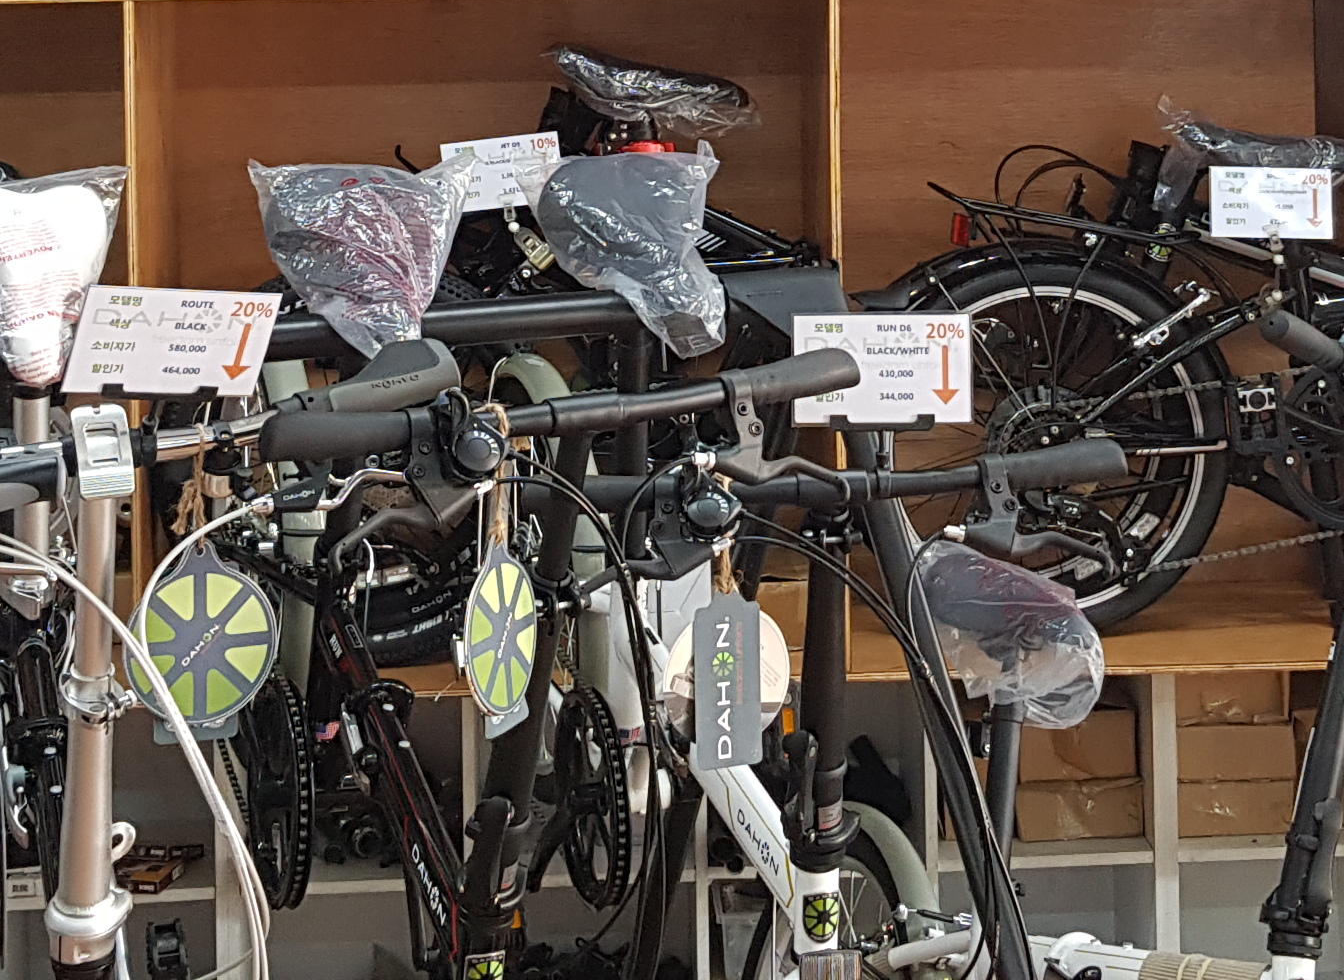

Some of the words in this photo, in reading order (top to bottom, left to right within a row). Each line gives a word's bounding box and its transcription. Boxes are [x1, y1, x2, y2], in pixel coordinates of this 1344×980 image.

[530, 137, 556, 150] 10%
[1301, 173, 1329, 185] 20%
[108, 295, 144, 308] 모델명
[181, 300, 215, 309] ROUTE
[230, 301, 274, 318] 20%
[109, 318, 132, 329] 색상
[174, 322, 208, 331] BLACK
[814, 323, 844, 333] 모델명
[876, 324, 897, 332] RUN
[899, 324, 912, 332] D6
[925, 322, 964, 340] 20%
[90, 340, 136, 352] 소비자가
[168, 344, 207, 354] 580,000
[866, 346, 930, 356] BLACK/WHITE
[91, 363, 124, 374] 할인가
[162, 366, 201, 376] 464,000
[878, 369, 914, 379] 430,000
[879, 391, 914, 401] 344,000
[282, 488, 316, 501] DAHON
[411, 589, 453, 614] DAHON
[497, 611, 514, 660] DAHON
[181, 623, 221, 667] DAHON
[712, 620, 735, 760] DAHON
[736, 808, 781, 877] DAHON
[410, 843, 448, 928] DAHON
